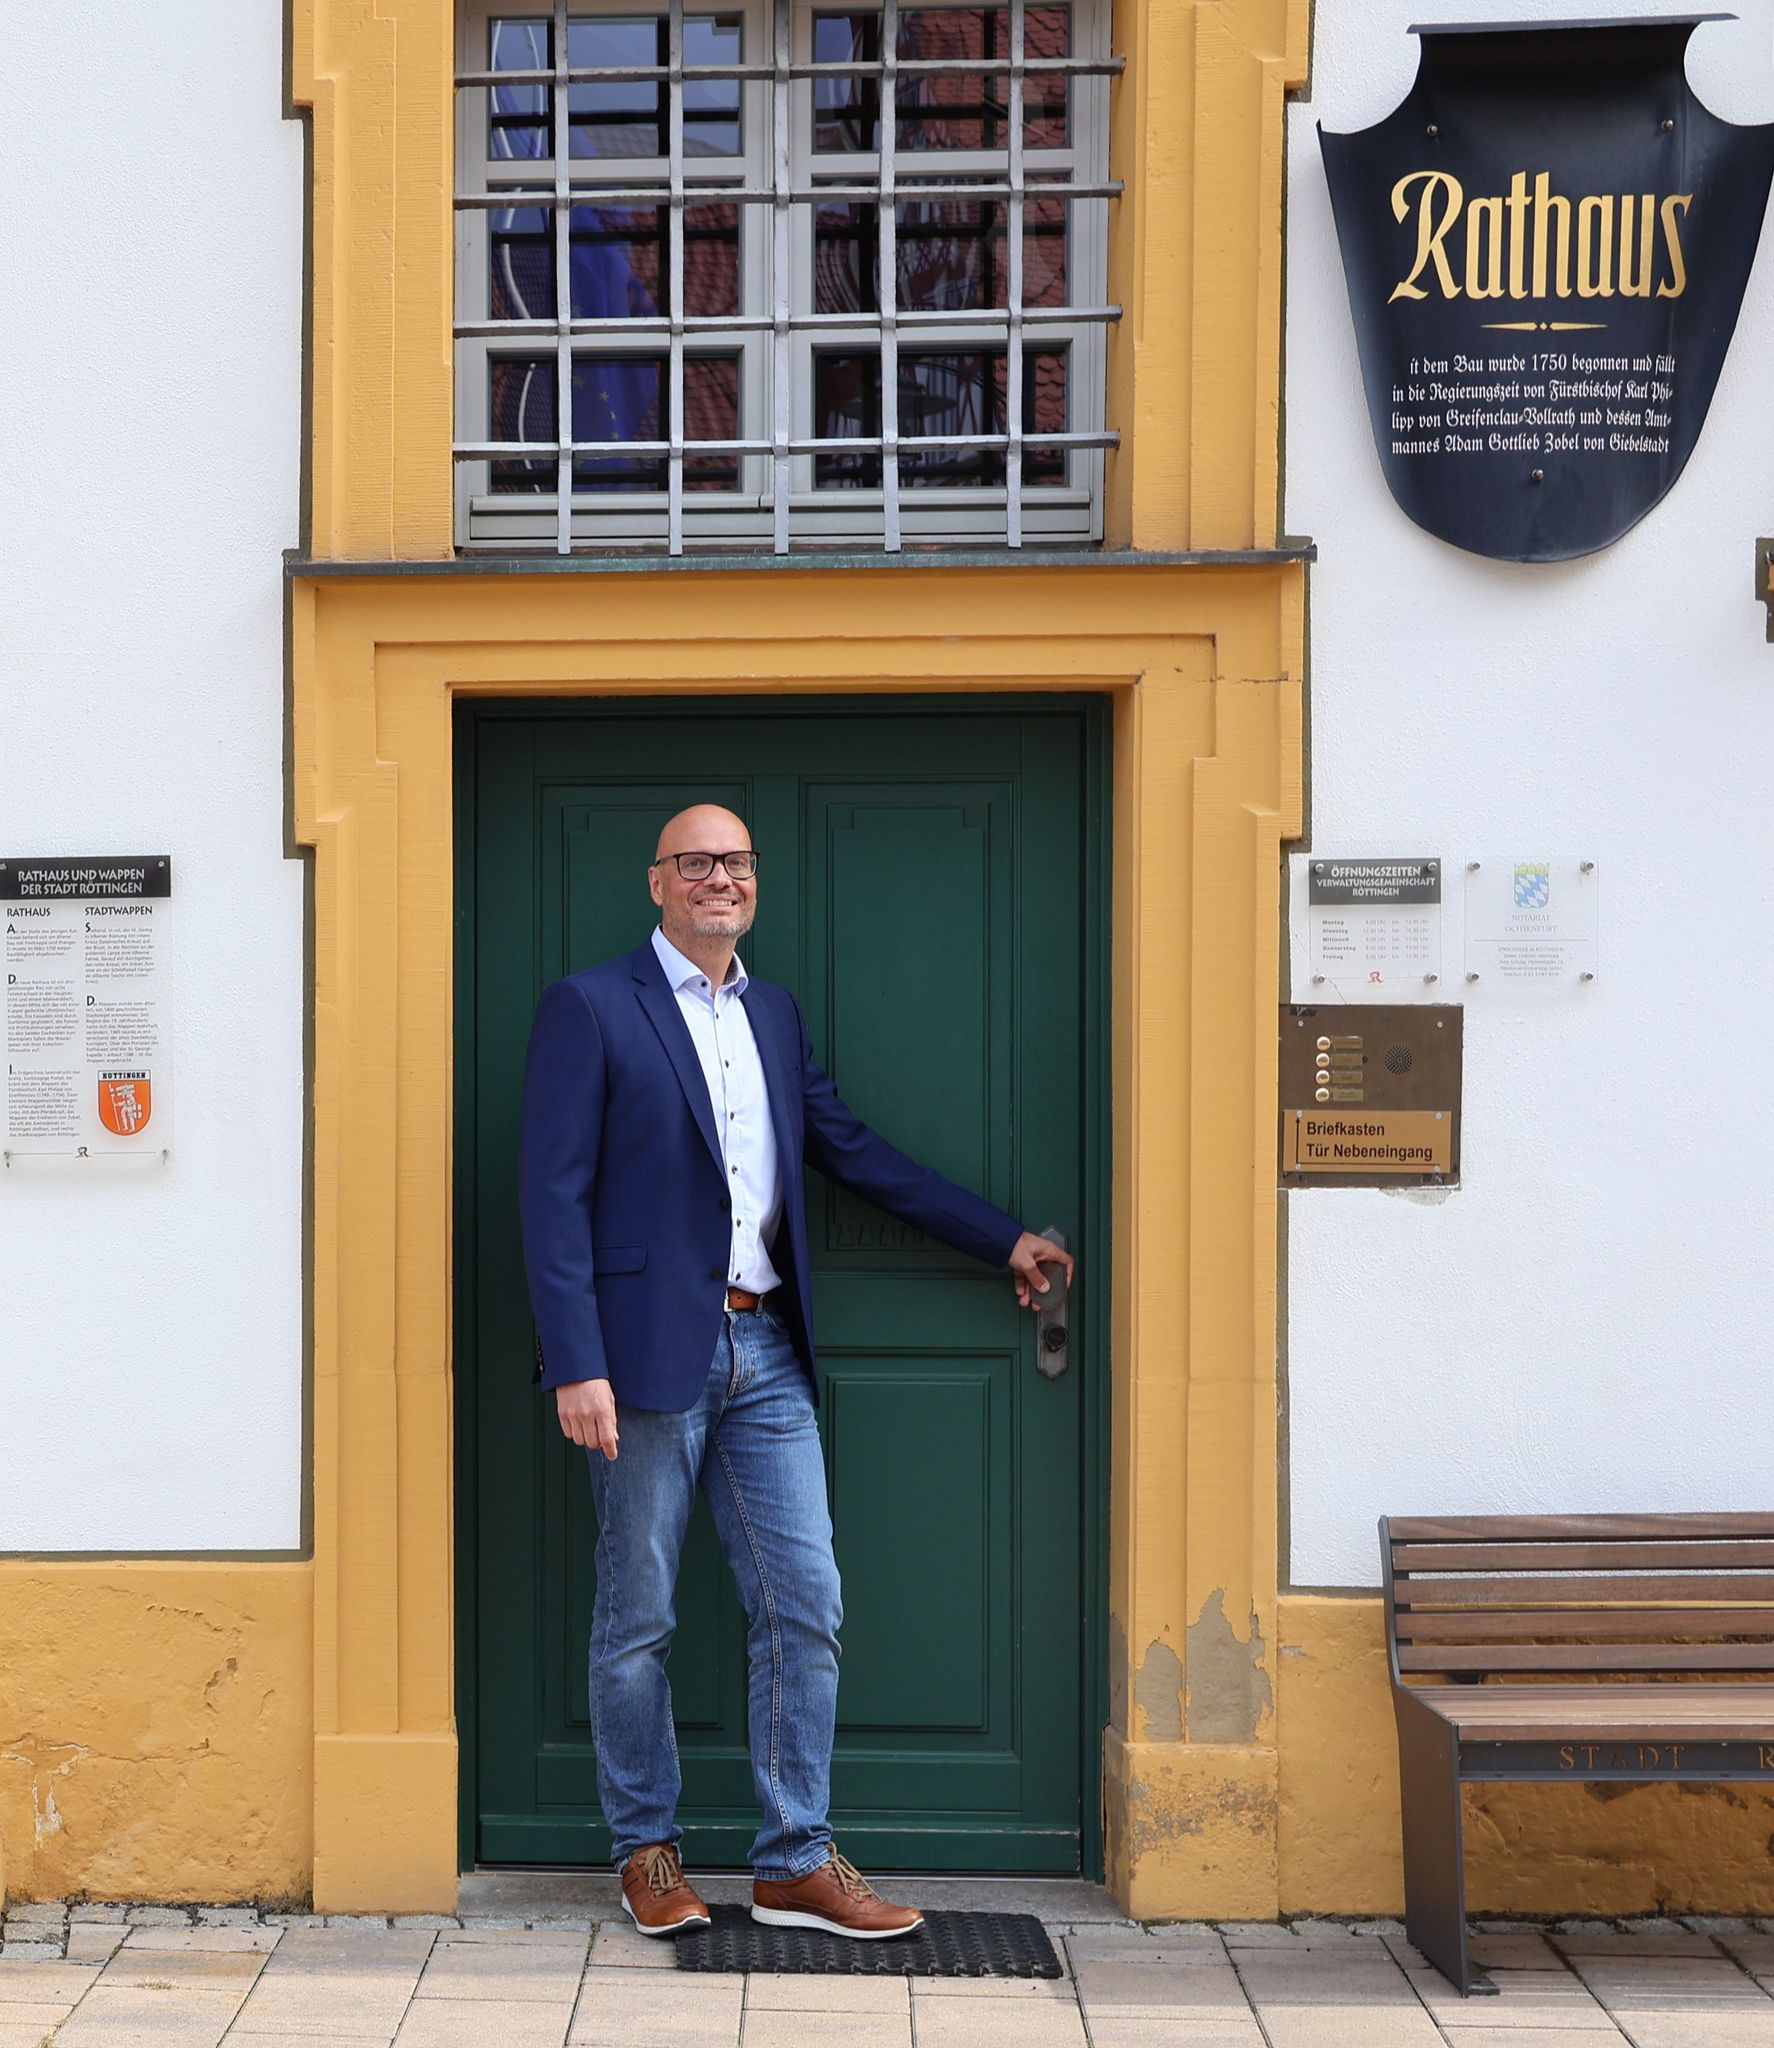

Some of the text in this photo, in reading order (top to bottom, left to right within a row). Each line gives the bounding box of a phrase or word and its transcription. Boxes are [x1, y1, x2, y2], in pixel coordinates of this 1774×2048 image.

[1387, 170, 1693, 304] Rathaus
[1423, 356, 1449, 374] dem
[1453, 354, 1484, 373] Bau
[1488, 354, 1526, 372] wurde
[1531, 353, 1568, 372] 1750
[1572, 353, 1628, 375] begonnen
[1633, 354, 1653, 373] und
[1655, 354, 1676, 376] fällt
[1392, 385, 1404, 402] in
[1408, 384, 1426, 402] die
[1429, 381, 1520, 404] Regierungszeit
[1523, 384, 1545, 399] von
[1548, 379, 1624, 402] Fürstbischof
[1624, 380, 1649, 400] Karl
[1391, 411, 1415, 433] lipp
[1418, 414, 1441, 428] von
[1580, 407, 1603, 425] und
[1606, 407, 1642, 426] dessen
[1391, 432, 1670, 455] mannes Adam Gottlieb Zobel von Giebelstadt
[18, 868, 145, 882] RATHAUS UND WAPPEN
[1331, 864, 1421, 878] ÖFFNUNGSZEITEN
[21, 880, 143, 895] DER STADT RÖTTINGEN
[1316, 877, 1436, 887] VERWALTUNGSGEMEINSCHAFT
[1352, 886, 1400, 897] RÖTTINGEN
[6, 907, 51, 917] RATHAUS
[84, 905, 153, 916] STADTWAPPEN
[1307, 1121, 1385, 1136] Briefkasten
[1306, 1143, 1433, 1162] Tür Nebeneingang
[1559, 1745, 1686, 1769] STADT
